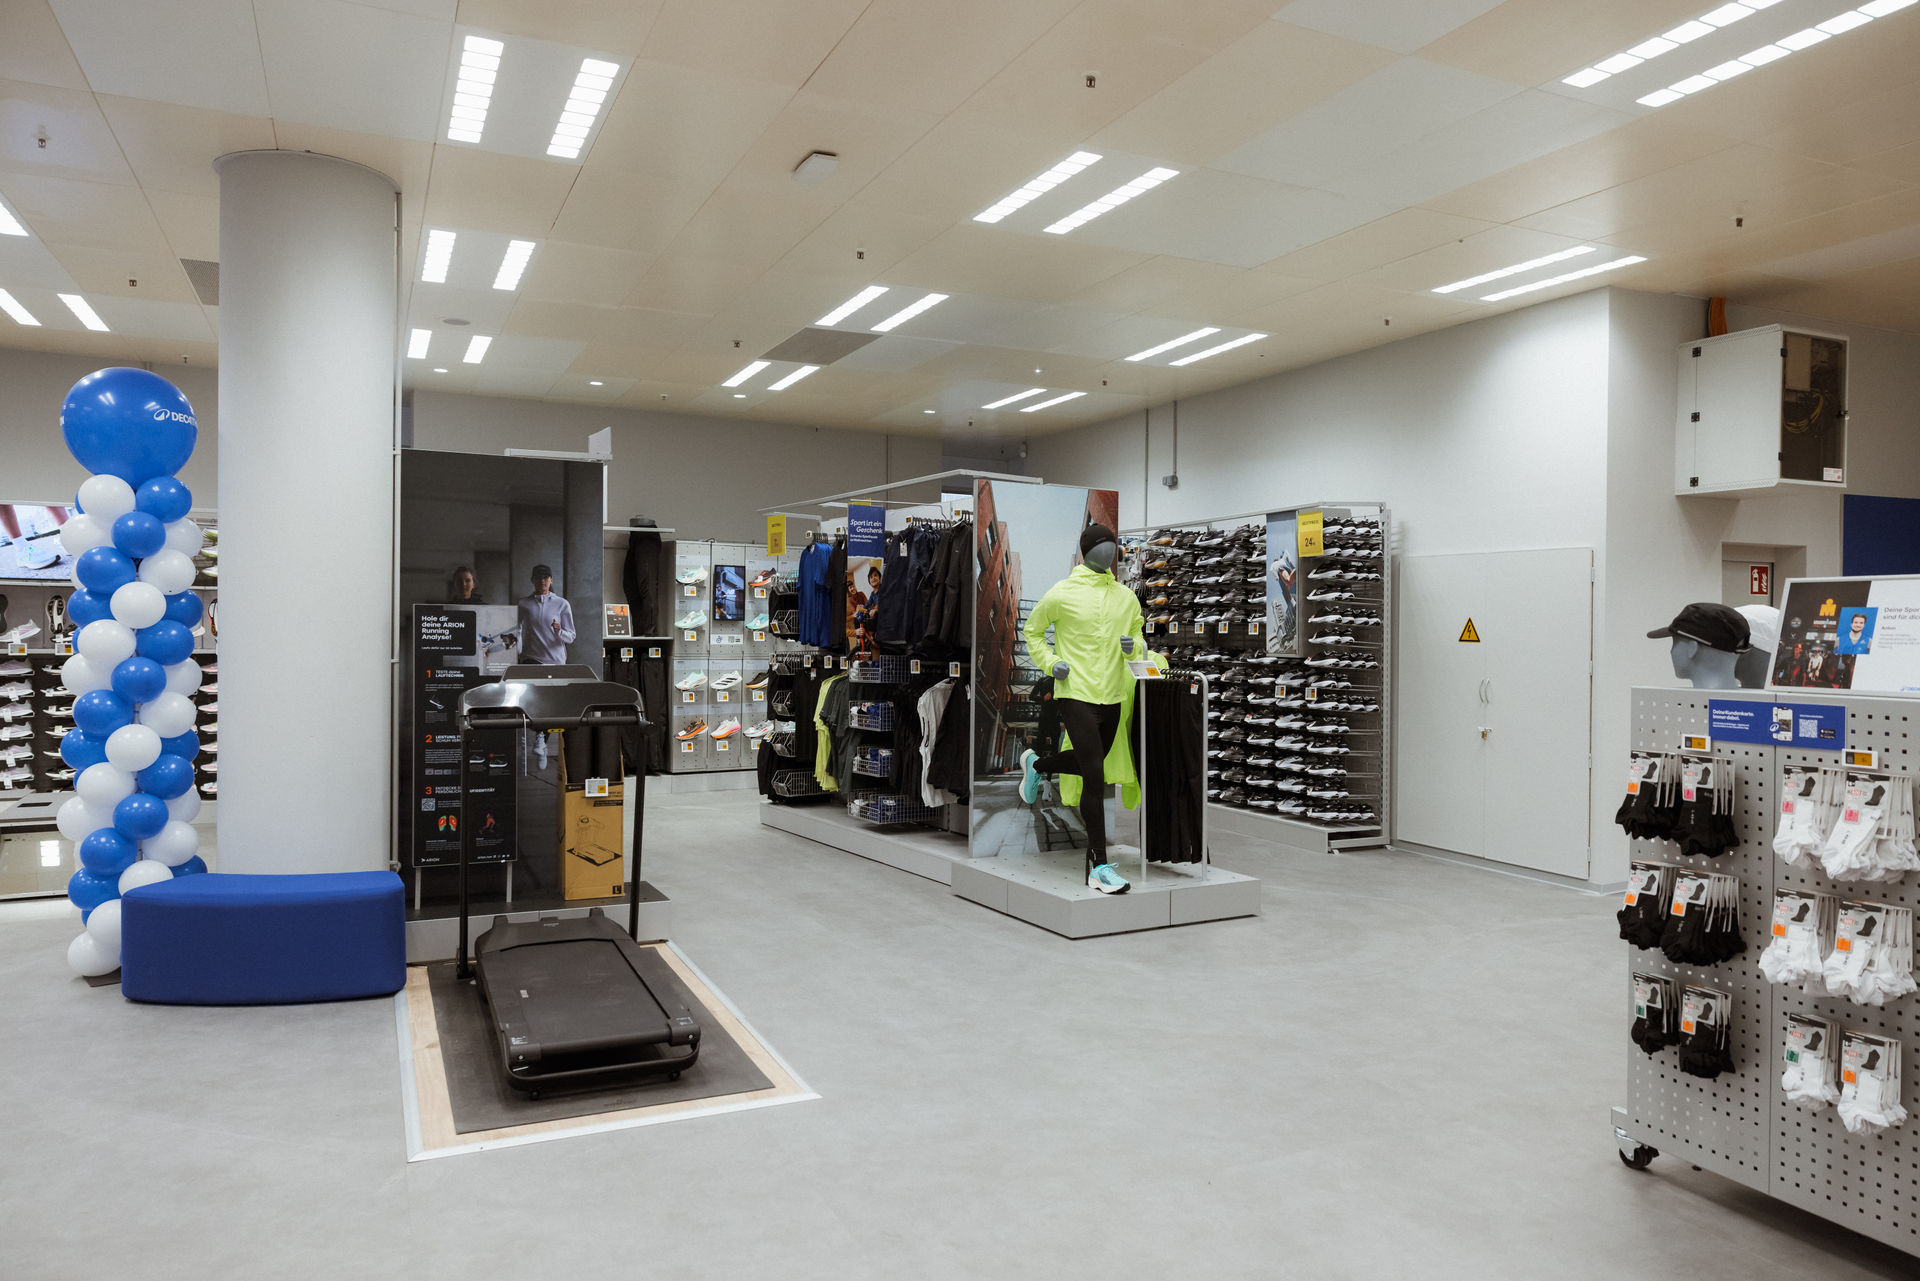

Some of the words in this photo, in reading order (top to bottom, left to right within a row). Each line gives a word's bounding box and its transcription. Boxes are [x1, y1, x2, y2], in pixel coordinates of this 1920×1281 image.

[171, 411, 197, 425] DECAT
[850, 519, 866, 527] Sport
[1305, 537, 1313, 547] 24
[427, 670, 431, 678] 1
[425, 734, 432, 743] 2
[425, 786, 432, 795] 3
